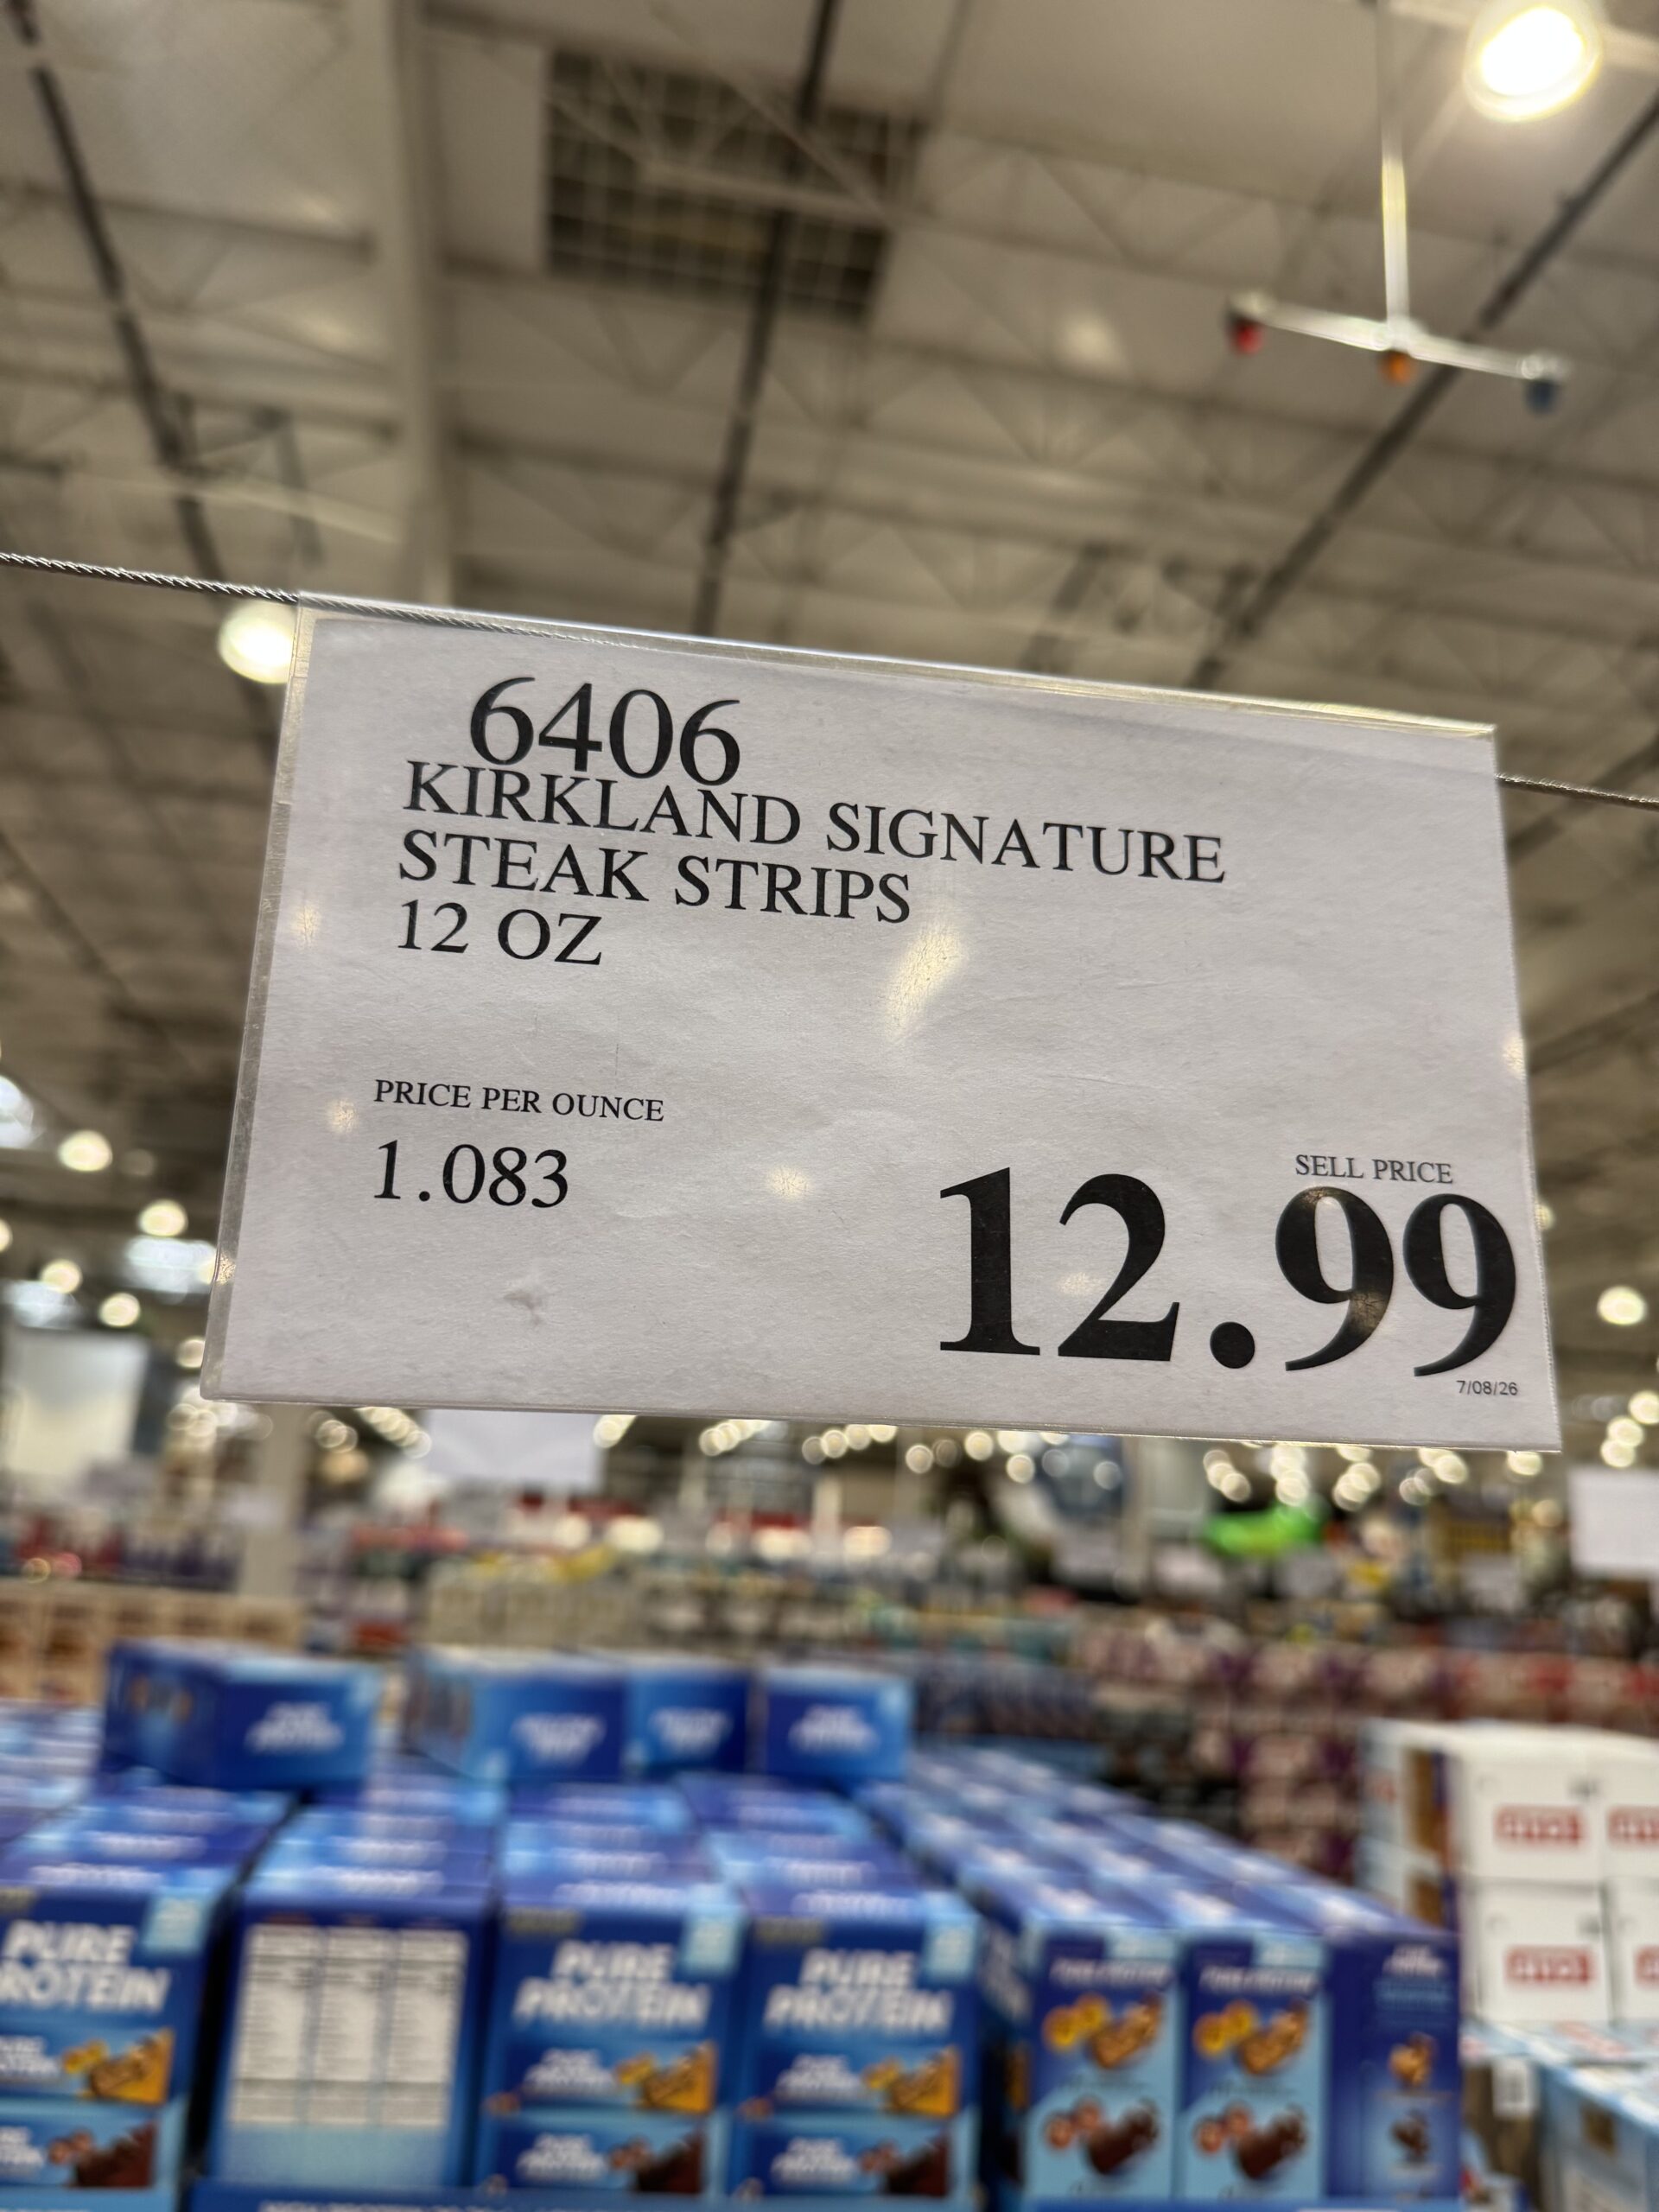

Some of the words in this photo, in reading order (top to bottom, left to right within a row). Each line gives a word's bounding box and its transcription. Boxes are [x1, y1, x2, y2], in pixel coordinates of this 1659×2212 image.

[469, 677, 741, 786] 6406
[403, 760, 801, 845] KIRKLAND
[826, 802, 1226, 884] SIGNATURE
[398, 829, 650, 902] STEAK
[674, 855, 911, 925] STRIPS
[397, 899, 469, 954] 12
[497, 908, 602, 966] OZ
[373, 1078, 472, 1109] PRICE
[480, 1086, 543, 1114] PER
[551, 1092, 664, 1122] OUNCE
[373, 1139, 569, 1209] 1.083
[1295, 1154, 1363, 1179] SELL
[1372, 1159, 1453, 1184] PRICE
[939, 1166, 1516, 1377] 12.99
[1456, 1380, 1518, 1397] 7/08/26
[3, 1918, 137, 1964] PURE
[551, 1939, 679, 1985] PURE
[0, 1958, 171, 2013] ROTEIN
[799, 1947, 918, 1993] PURE
[512, 1977, 711, 2031] PROTEIN
[762, 1986, 954, 2037] PROTEIN
